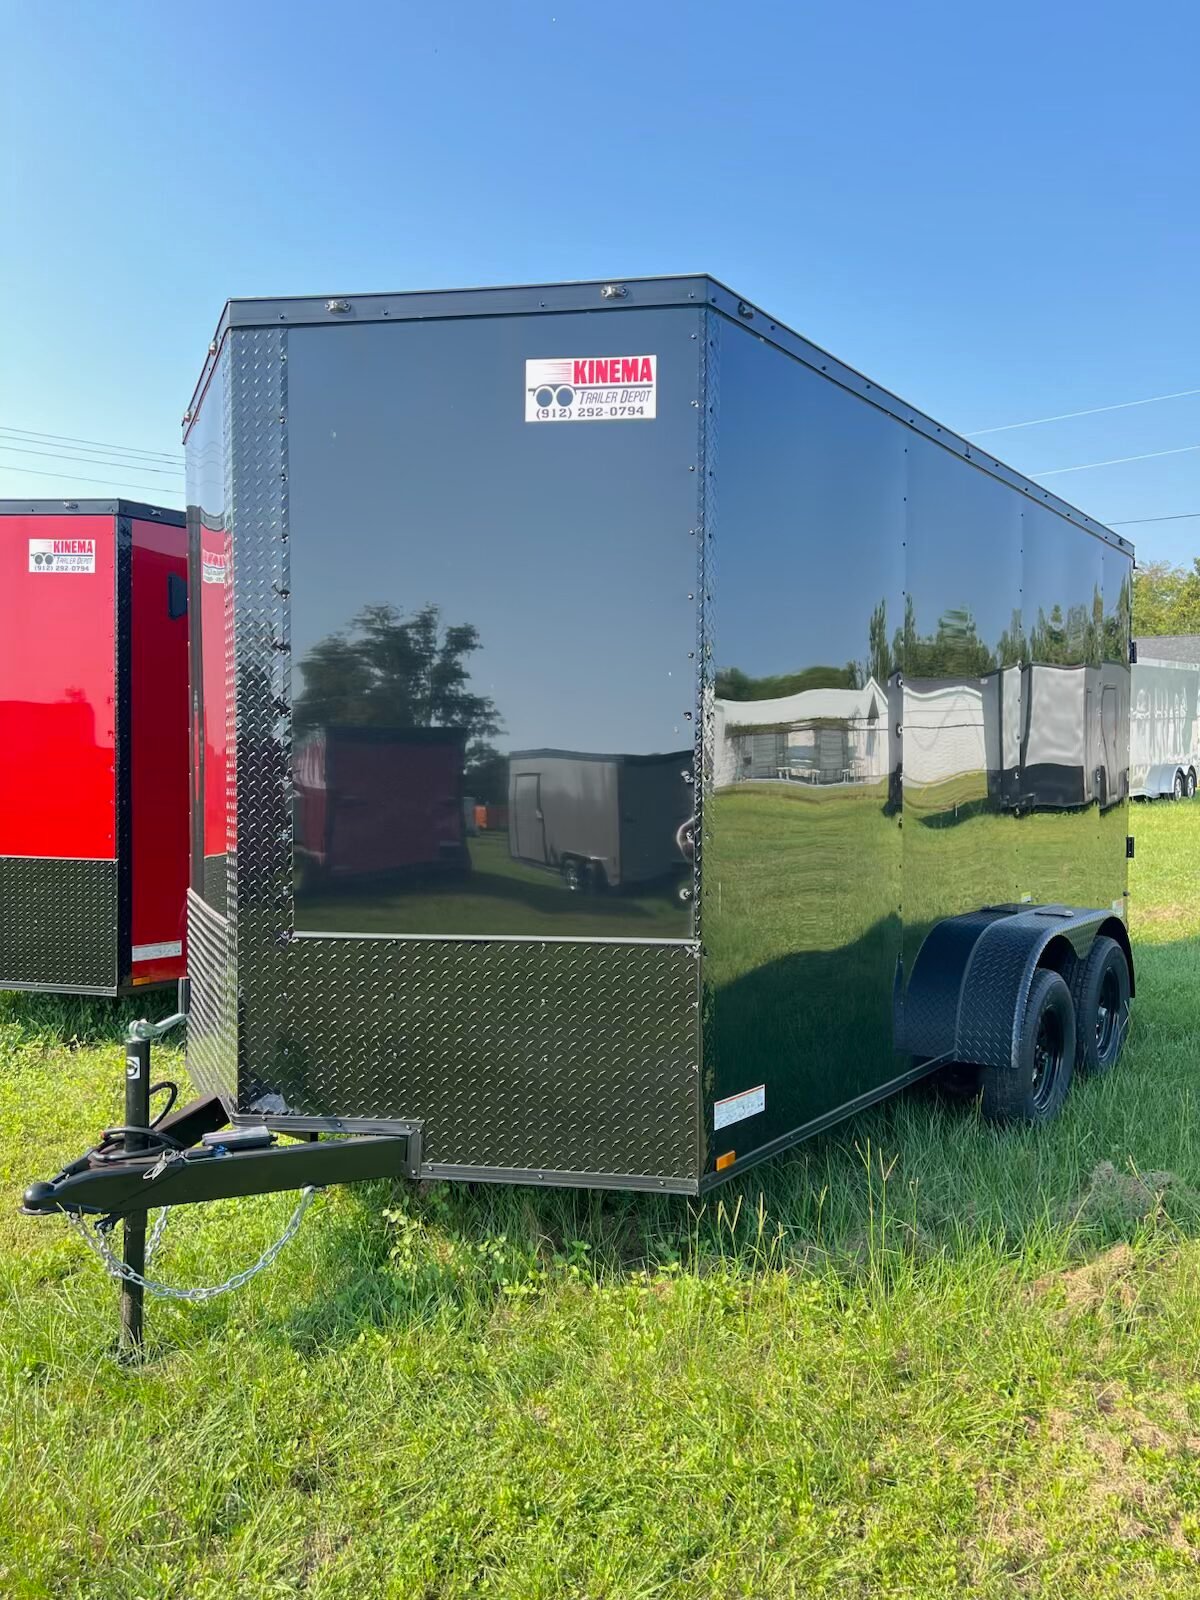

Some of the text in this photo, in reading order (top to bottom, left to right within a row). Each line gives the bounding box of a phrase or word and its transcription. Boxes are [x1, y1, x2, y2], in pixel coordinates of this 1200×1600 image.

[573, 358, 653, 384] KINEMA
[579, 389, 652, 405] TRAILER DEPOT
[536, 406, 644, 419] (912) 292-0794
[53, 541, 93, 553] KINEMA
